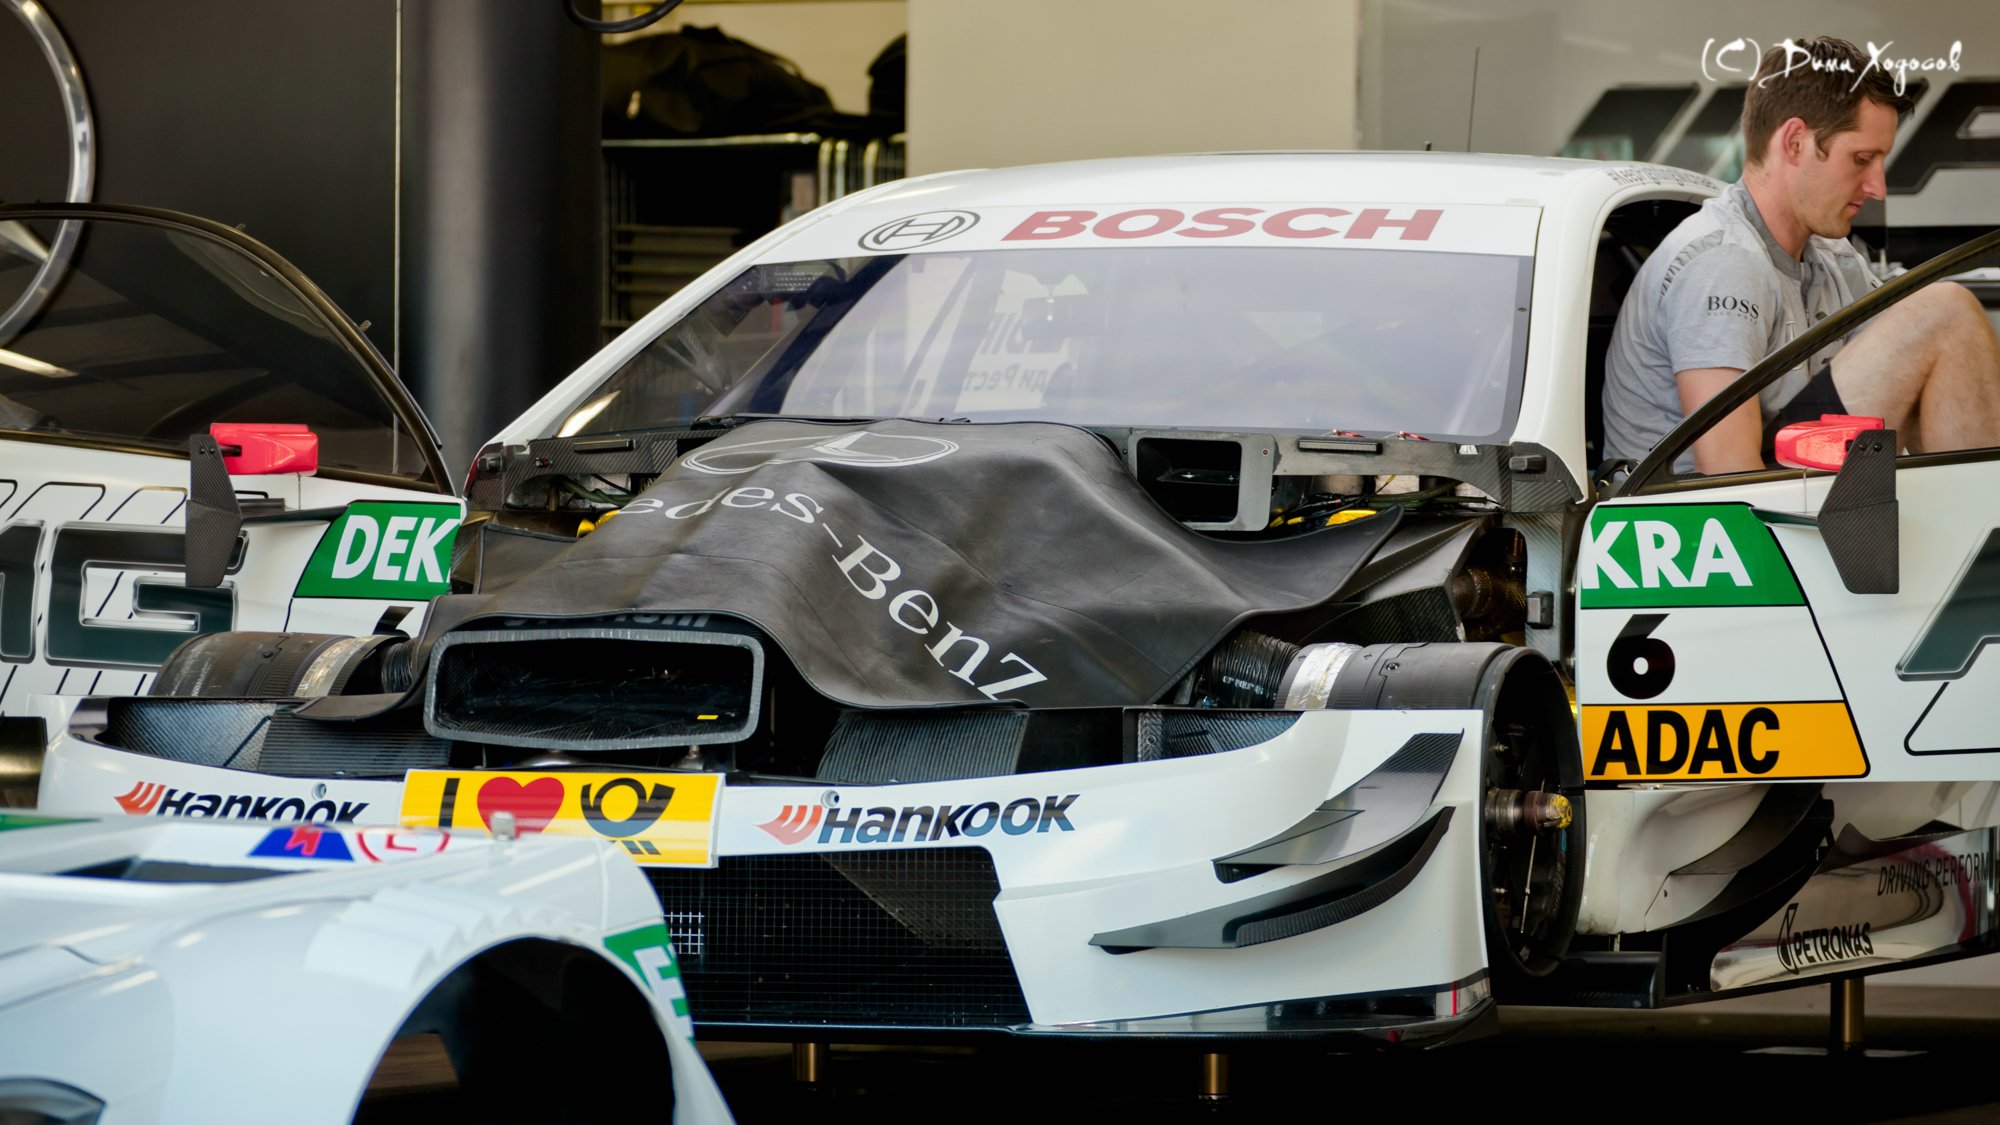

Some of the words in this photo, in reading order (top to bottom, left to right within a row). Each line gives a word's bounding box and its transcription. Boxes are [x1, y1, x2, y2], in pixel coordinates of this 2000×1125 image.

[999, 206, 1444, 242] BOSCH
[1707, 295, 1760, 319] BOSS
[331, 515, 461, 584] DEK
[1581, 518, 1753, 589] KRA
[1606, 613, 1677, 700] 6
[1591, 707, 1780, 776] ADAC
[1876, 858, 1932, 897] DRIVING
[1792, 921, 1875, 966] PETRONAS
